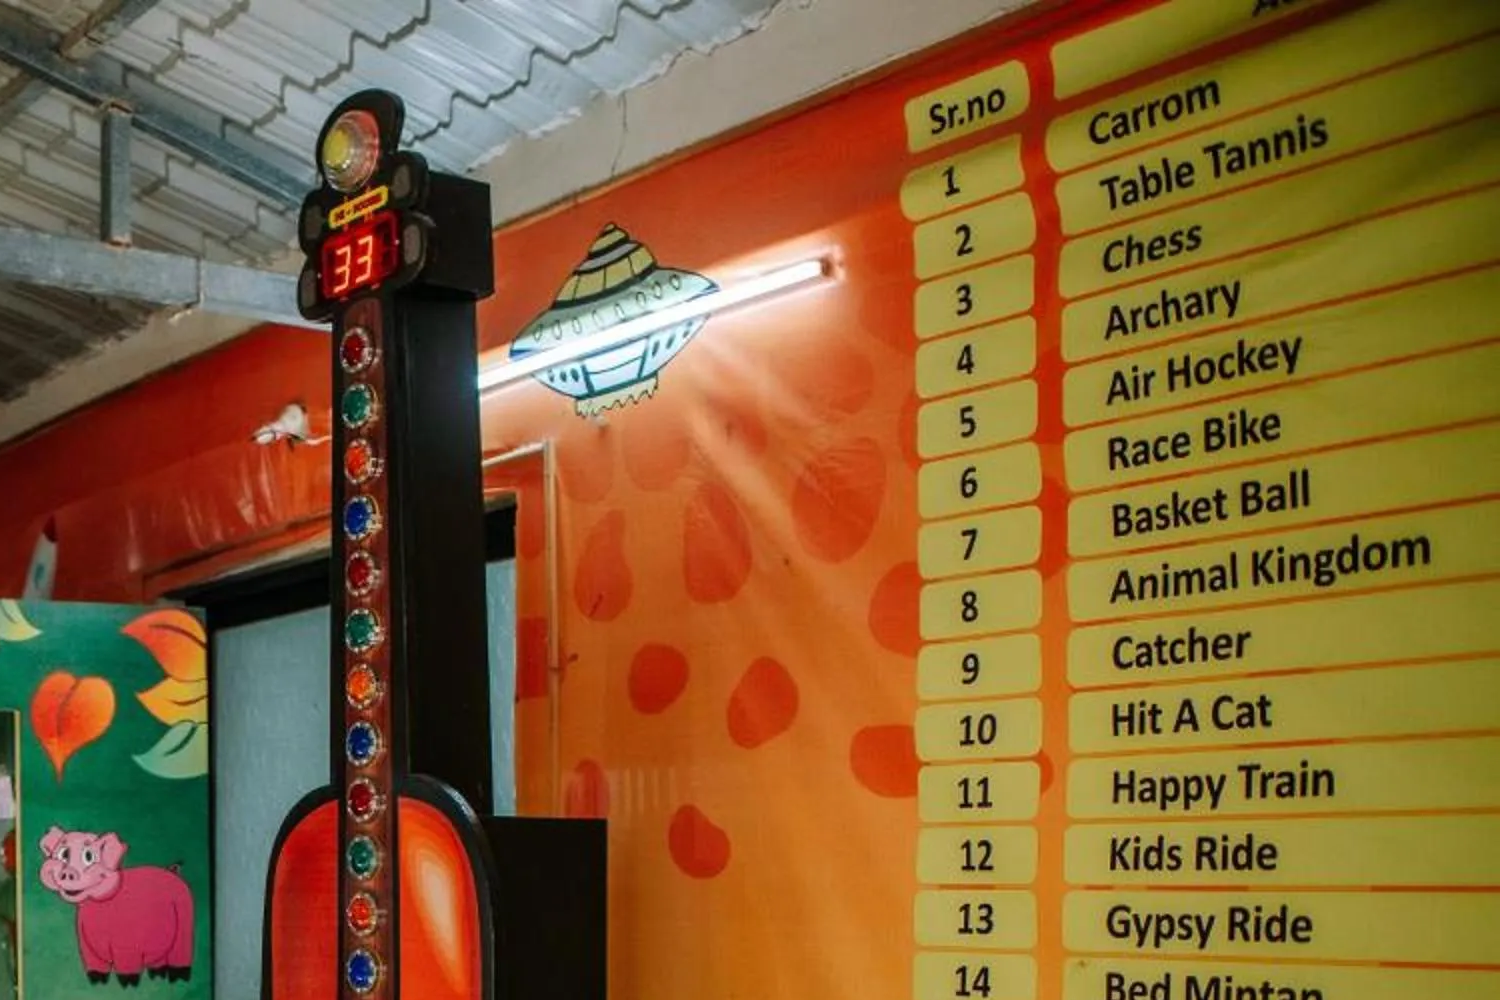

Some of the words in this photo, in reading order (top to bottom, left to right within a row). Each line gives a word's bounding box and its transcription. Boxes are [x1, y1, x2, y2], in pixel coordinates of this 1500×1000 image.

[929, 87, 1006, 136] Sr.no
[1088, 80, 1221, 144] Carrom
[1100, 160, 1195, 210] Table
[1204, 114, 1328, 180] Tannis
[943, 167, 960, 196] 1
[955, 225, 972, 255] 2
[1103, 225, 1202, 273] Chess
[957, 285, 972, 315] 3
[1104, 281, 1241, 339] Archary
[957, 345, 973, 375] 4
[1107, 366, 1155, 404] Air
[1168, 337, 1302, 392] Hockey
[960, 407, 976, 437] 5
[1108, 431, 1190, 470] Race
[1203, 411, 1281, 453] Bike
[960, 467, 977, 497] 6
[1112, 493, 1227, 537] Basket
[1241, 469, 1310, 517] Ball
[961, 530, 977, 559] 7
[1110, 553, 1238, 603] Animal
[1252, 534, 1431, 587] Kingdom
[961, 591, 978, 621] 8
[1112, 627, 1251, 670] Catcher
[962, 654, 979, 684] 9
[959, 714, 997, 746] 10
[1112, 703, 1161, 736] Hit
[1173, 699, 1198, 732] A
[1212, 694, 1272, 729] Cat
[957, 777, 993, 808] 11
[1112, 770, 1226, 810] Happy
[1239, 761, 1335, 800] Train
[960, 840, 994, 871] 12
[1110, 836, 1182, 870] Kids
[1196, 834, 1278, 870] Ride
[957, 904, 994, 935] 13
[1107, 906, 1215, 949] Gypsy
[1228, 907, 1312, 943] Ride
[954, 967, 990, 997] 14
